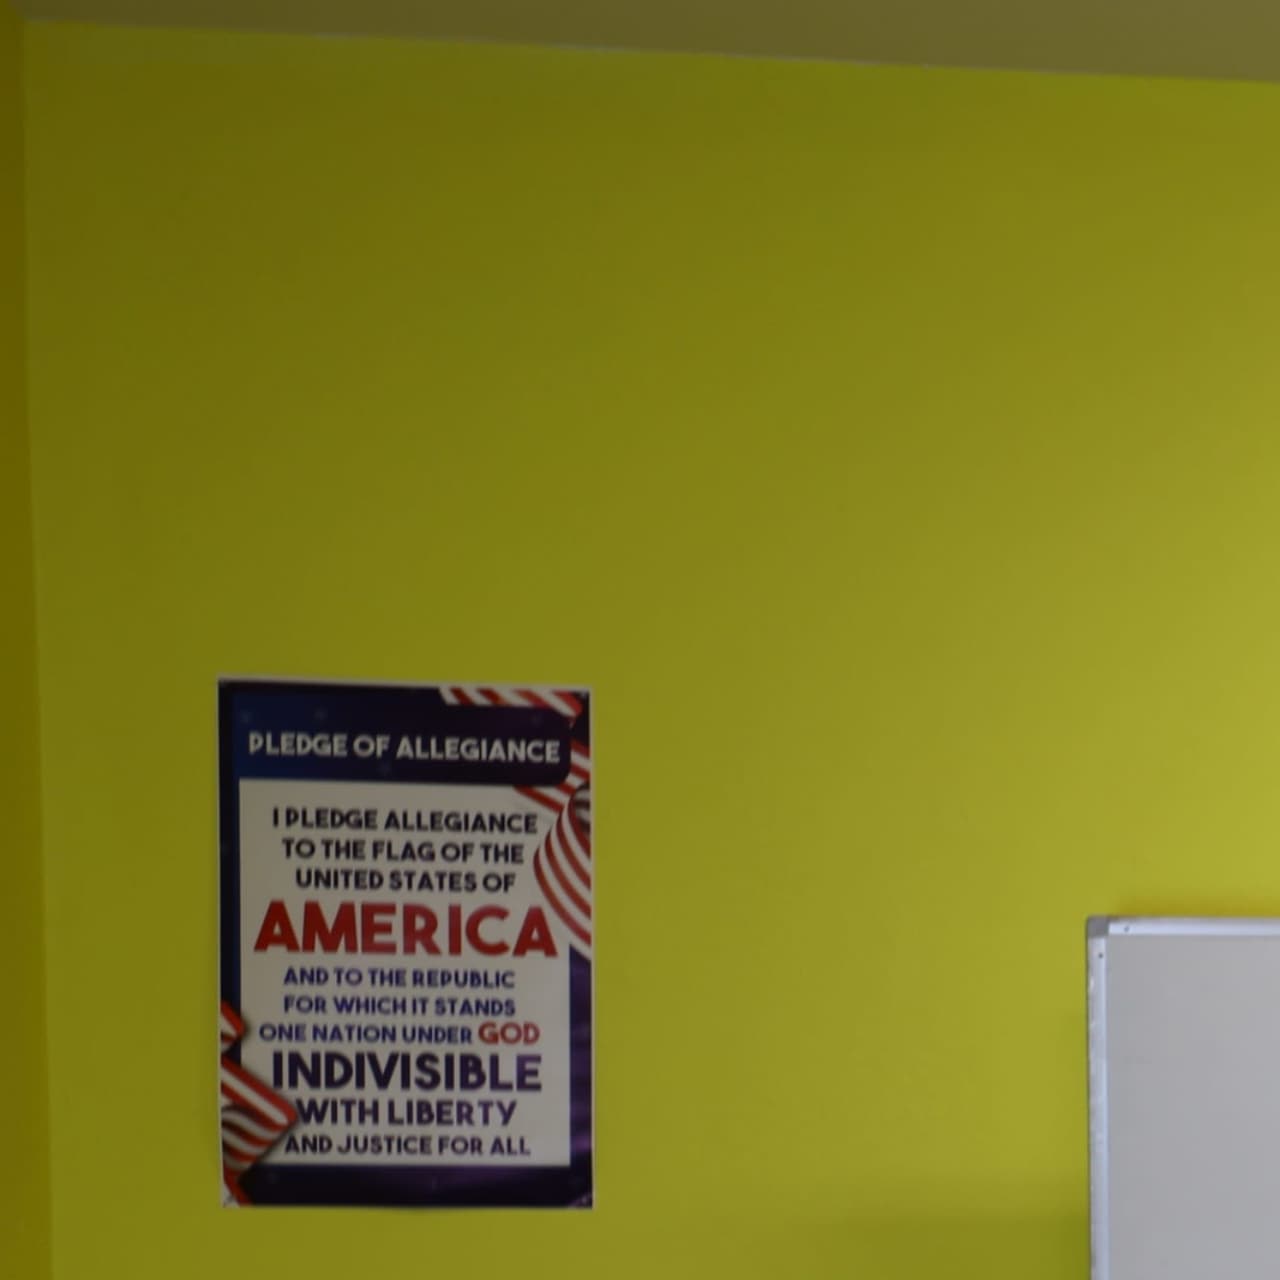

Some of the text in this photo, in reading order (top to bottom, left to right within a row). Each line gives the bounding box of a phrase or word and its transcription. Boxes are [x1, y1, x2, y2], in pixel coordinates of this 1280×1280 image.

[248, 731, 561, 764] PLEDGE OF ALLEGIANCE
[273, 806, 538, 834] I PLEDGE ALLEGIANCE
[282, 838, 525, 864] TO THE FLAG OF THE
[295, 869, 516, 893] UNITED STATES OF
[253, 899, 558, 958] AMERICA
[283, 967, 516, 989] AND TO THE REPUBLIC
[283, 995, 516, 1017] FOR WHICH IT STANDS
[259, 1022, 540, 1045] ONE NATION UNDER GOD
[272, 1051, 543, 1092] INDIVISIBLE
[297, 1097, 517, 1127] WITH LIBERTY
[284, 1135, 531, 1156] AND JUSTICE FOR ALL
